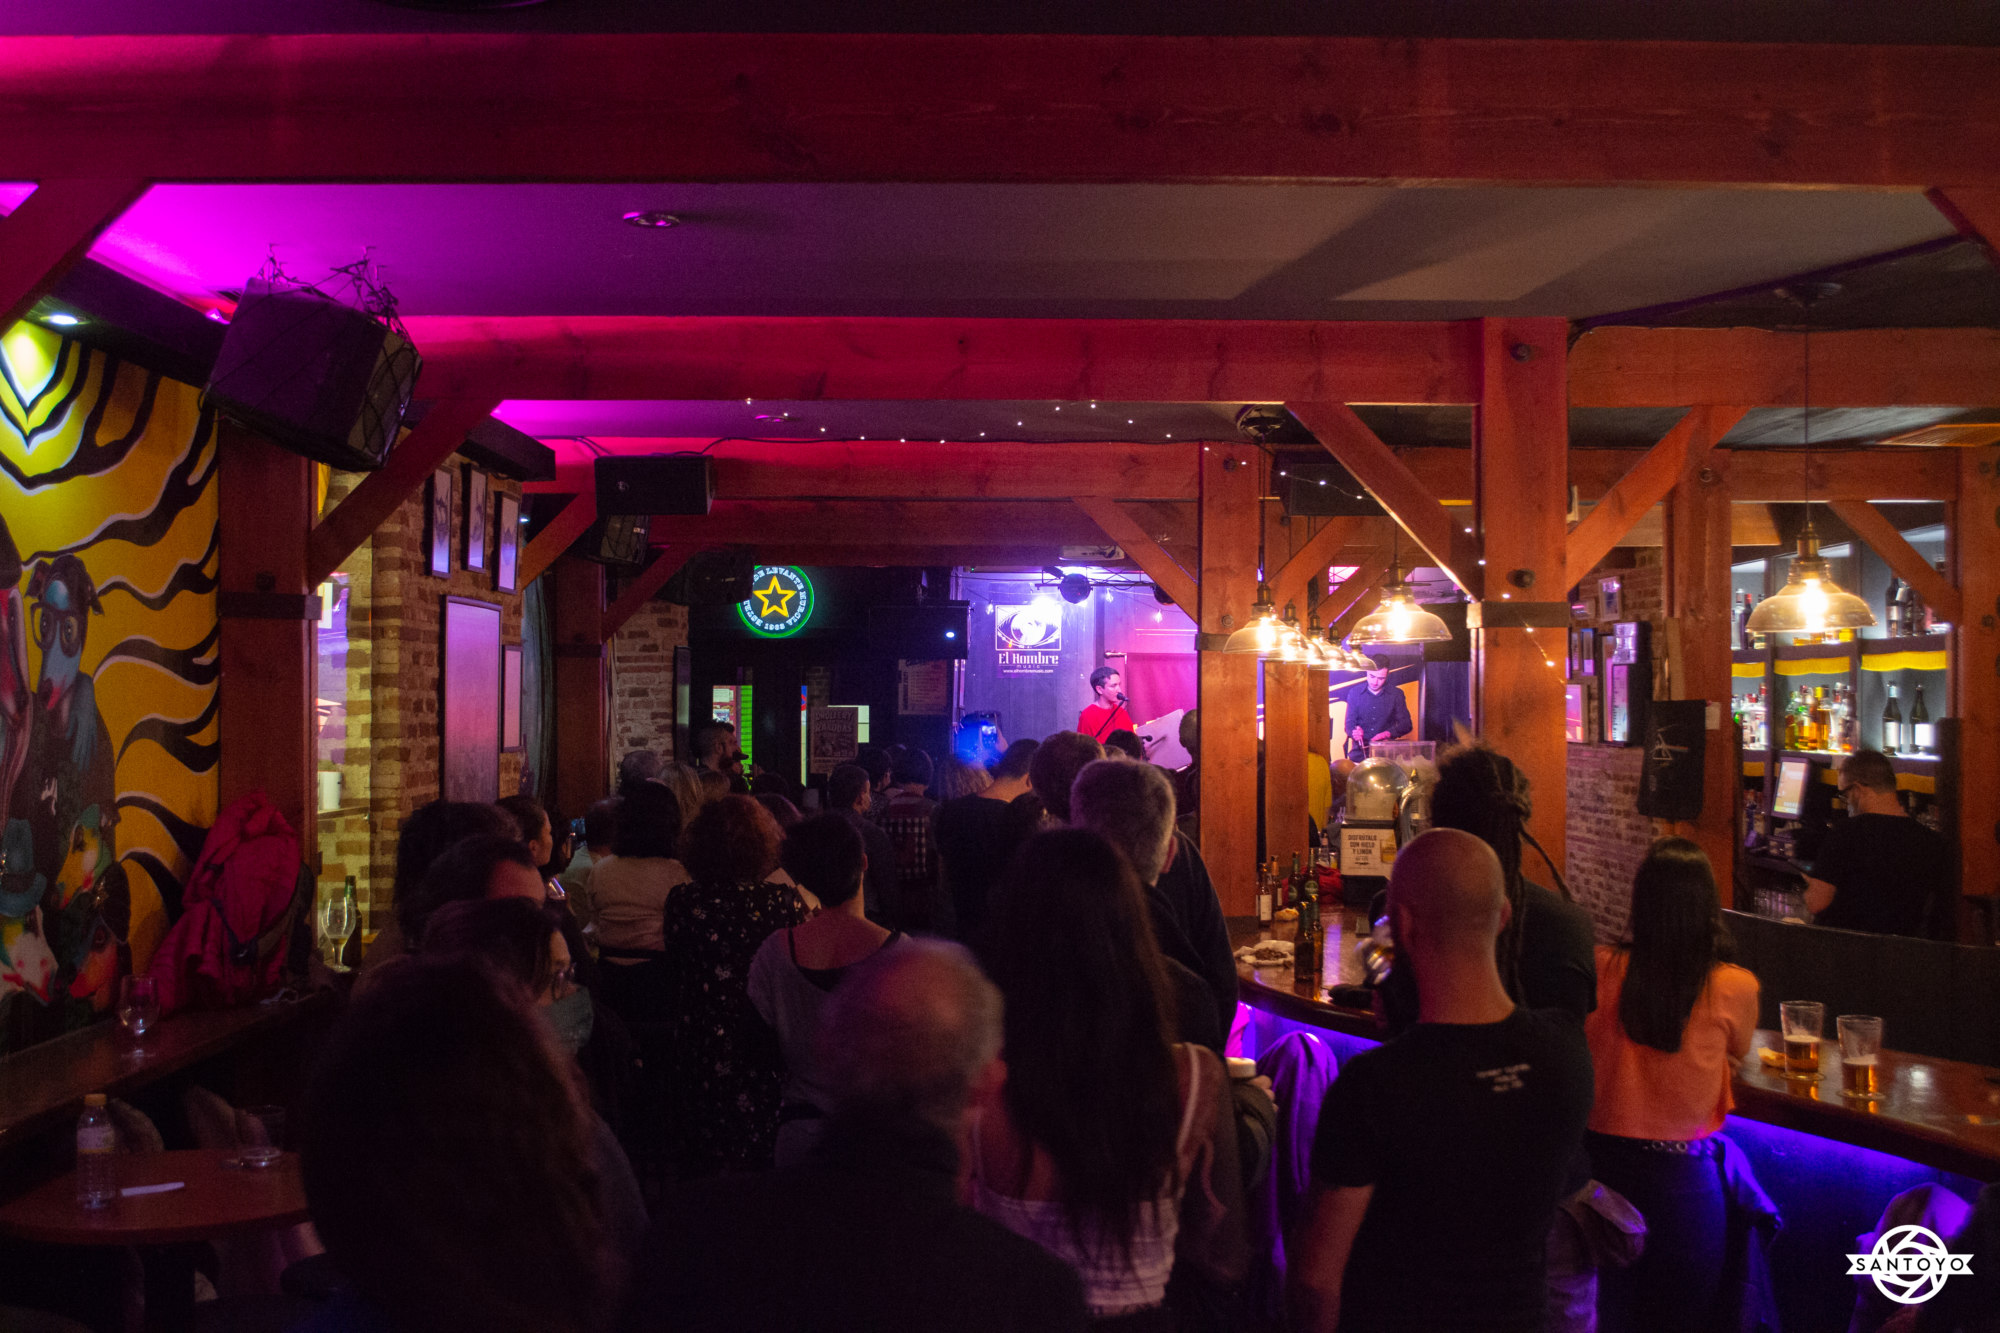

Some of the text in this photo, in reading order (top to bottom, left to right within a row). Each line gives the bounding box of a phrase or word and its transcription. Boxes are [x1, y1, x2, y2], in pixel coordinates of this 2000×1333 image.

[766, 567, 804, 590] LEVANTE
[786, 591, 807, 626] MURCIA
[998, 651, 1059, 664] El Hombre
